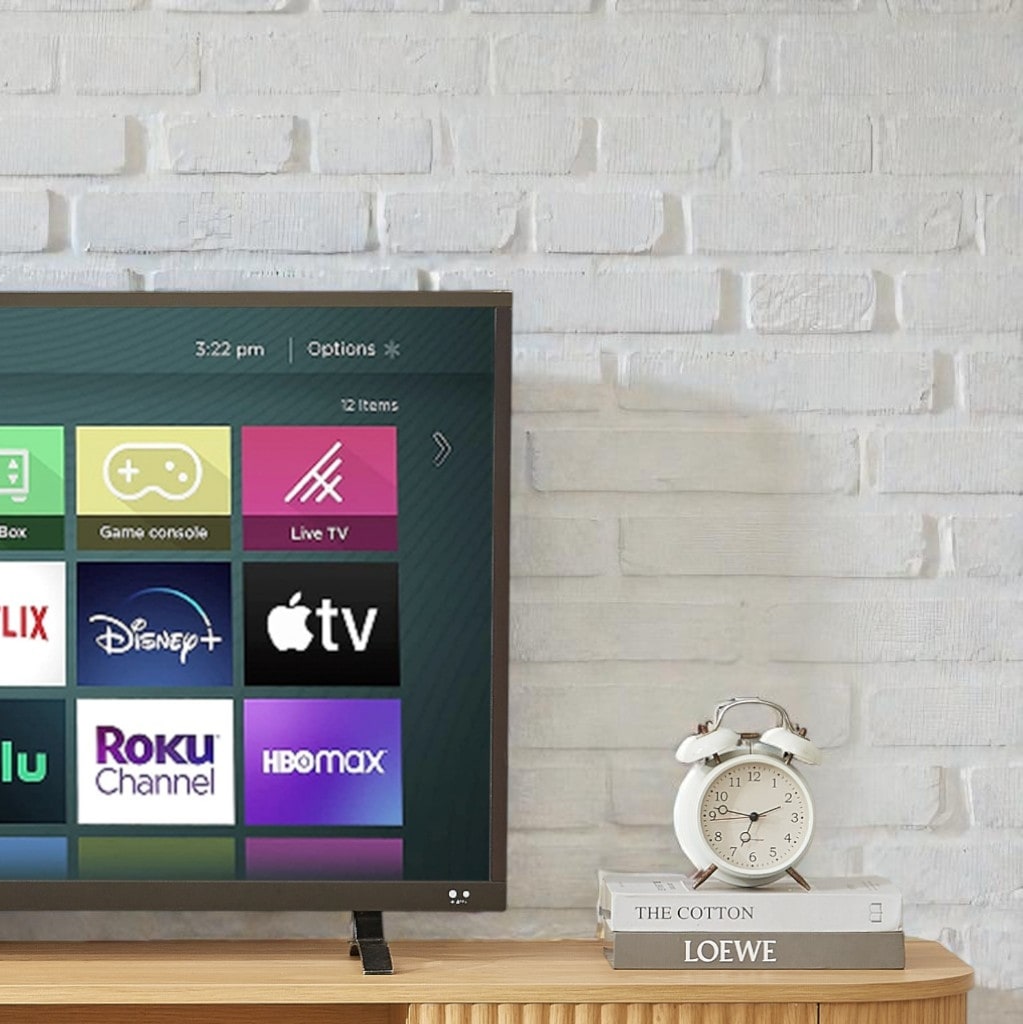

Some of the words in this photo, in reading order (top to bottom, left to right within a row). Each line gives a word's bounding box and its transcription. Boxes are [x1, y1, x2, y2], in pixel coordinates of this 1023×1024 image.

[195, 341, 231, 357] 3:22
[236, 345, 265, 360] pm
[307, 340, 376, 359] Options
[340, 398, 356, 412] 12
[357, 398, 399, 412] Items
[1, 525, 27, 540] Box
[99, 525, 145, 540] Game
[148, 525, 209, 540] console
[290, 525, 323, 541] Live
[325, 525, 349, 541] TV
[316, 599, 378, 652] tv
[95, 767, 215, 796] Channel
[729, 777, 741, 788] 11
[747, 771, 761, 782] 12
[715, 791, 728, 802] 10
[784, 793, 793, 803] 2
[791, 812, 799, 823] 3
[714, 831, 722, 842] 8
[784, 833, 792, 843] 4
[730, 847, 737, 857] 7
[749, 852, 757, 862] 6
[770, 847, 777, 857] 5
[635, 906, 672, 920] THE
[677, 906, 754, 920] COTTON
[684, 940, 776, 962] LOEWE
